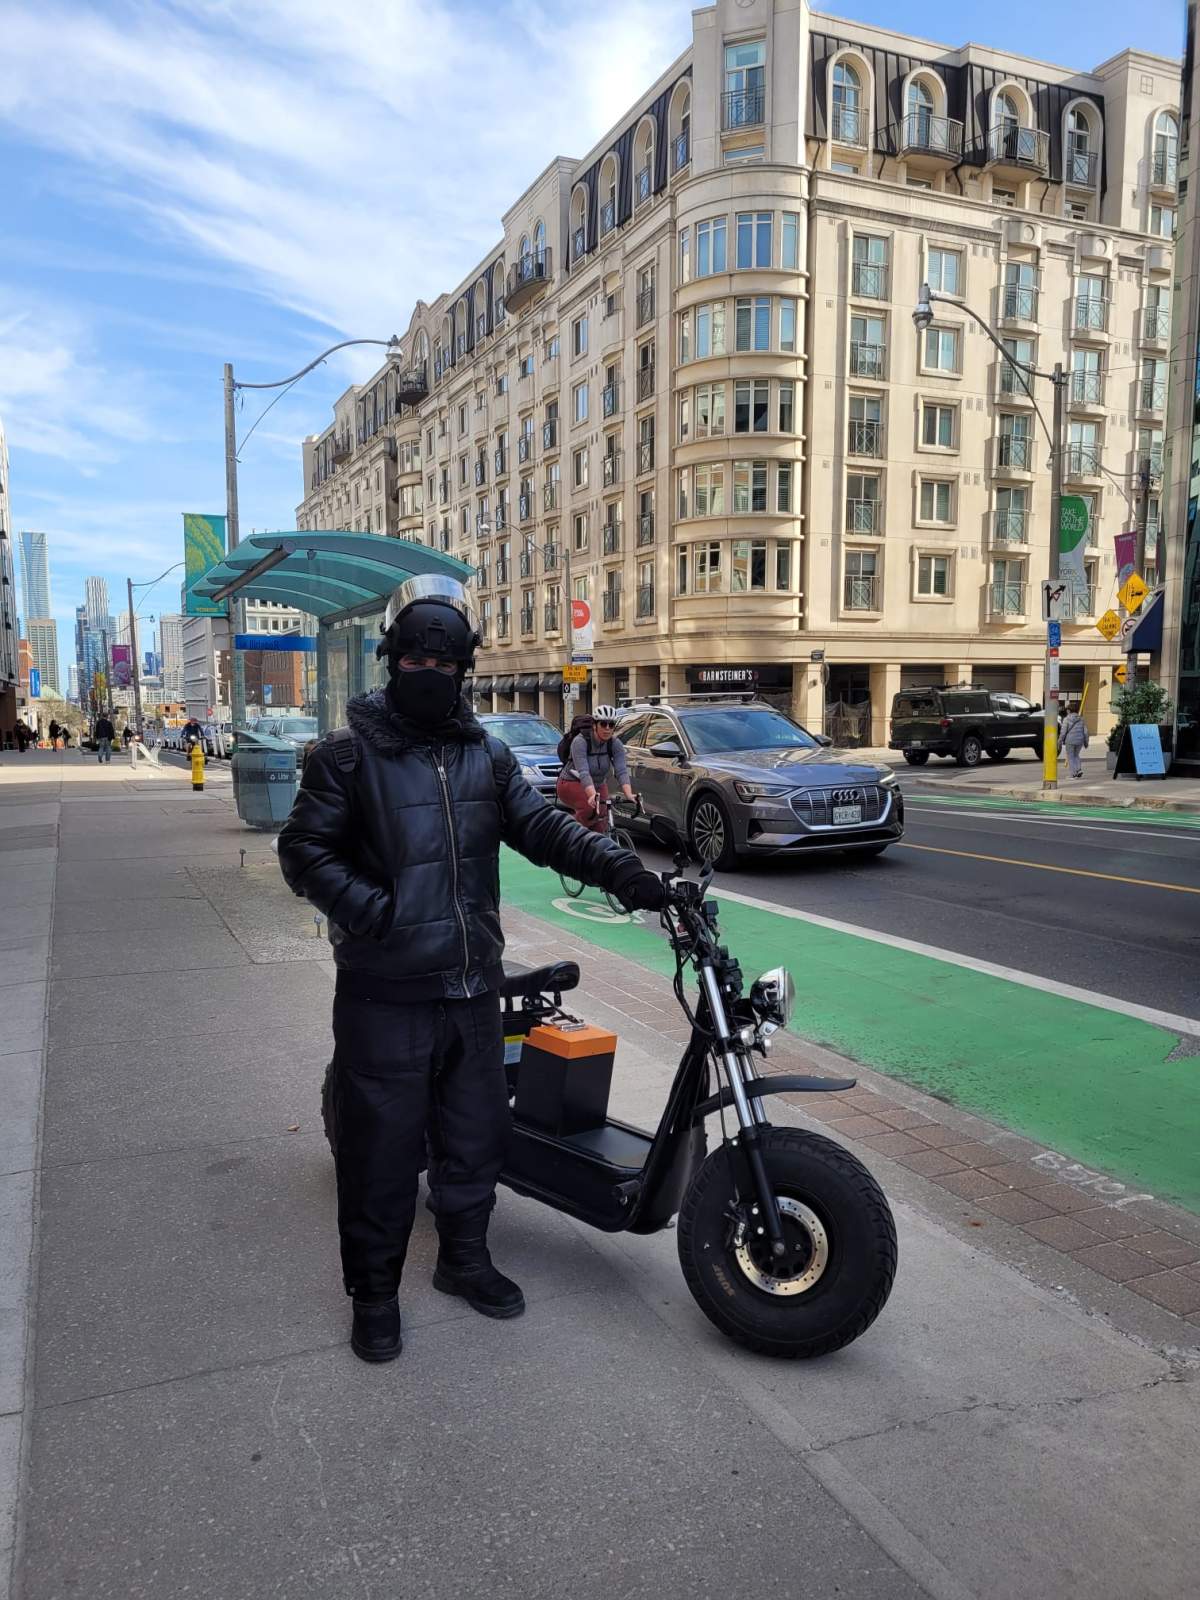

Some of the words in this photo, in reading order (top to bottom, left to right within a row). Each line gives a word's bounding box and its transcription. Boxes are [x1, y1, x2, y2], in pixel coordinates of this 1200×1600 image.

[1061, 508, 1076, 516] TAKE
[1061, 515, 1072, 524] ON
[1072, 515, 1085, 524] THE
[703, 668, 752, 681] BARNSTEINER'S
